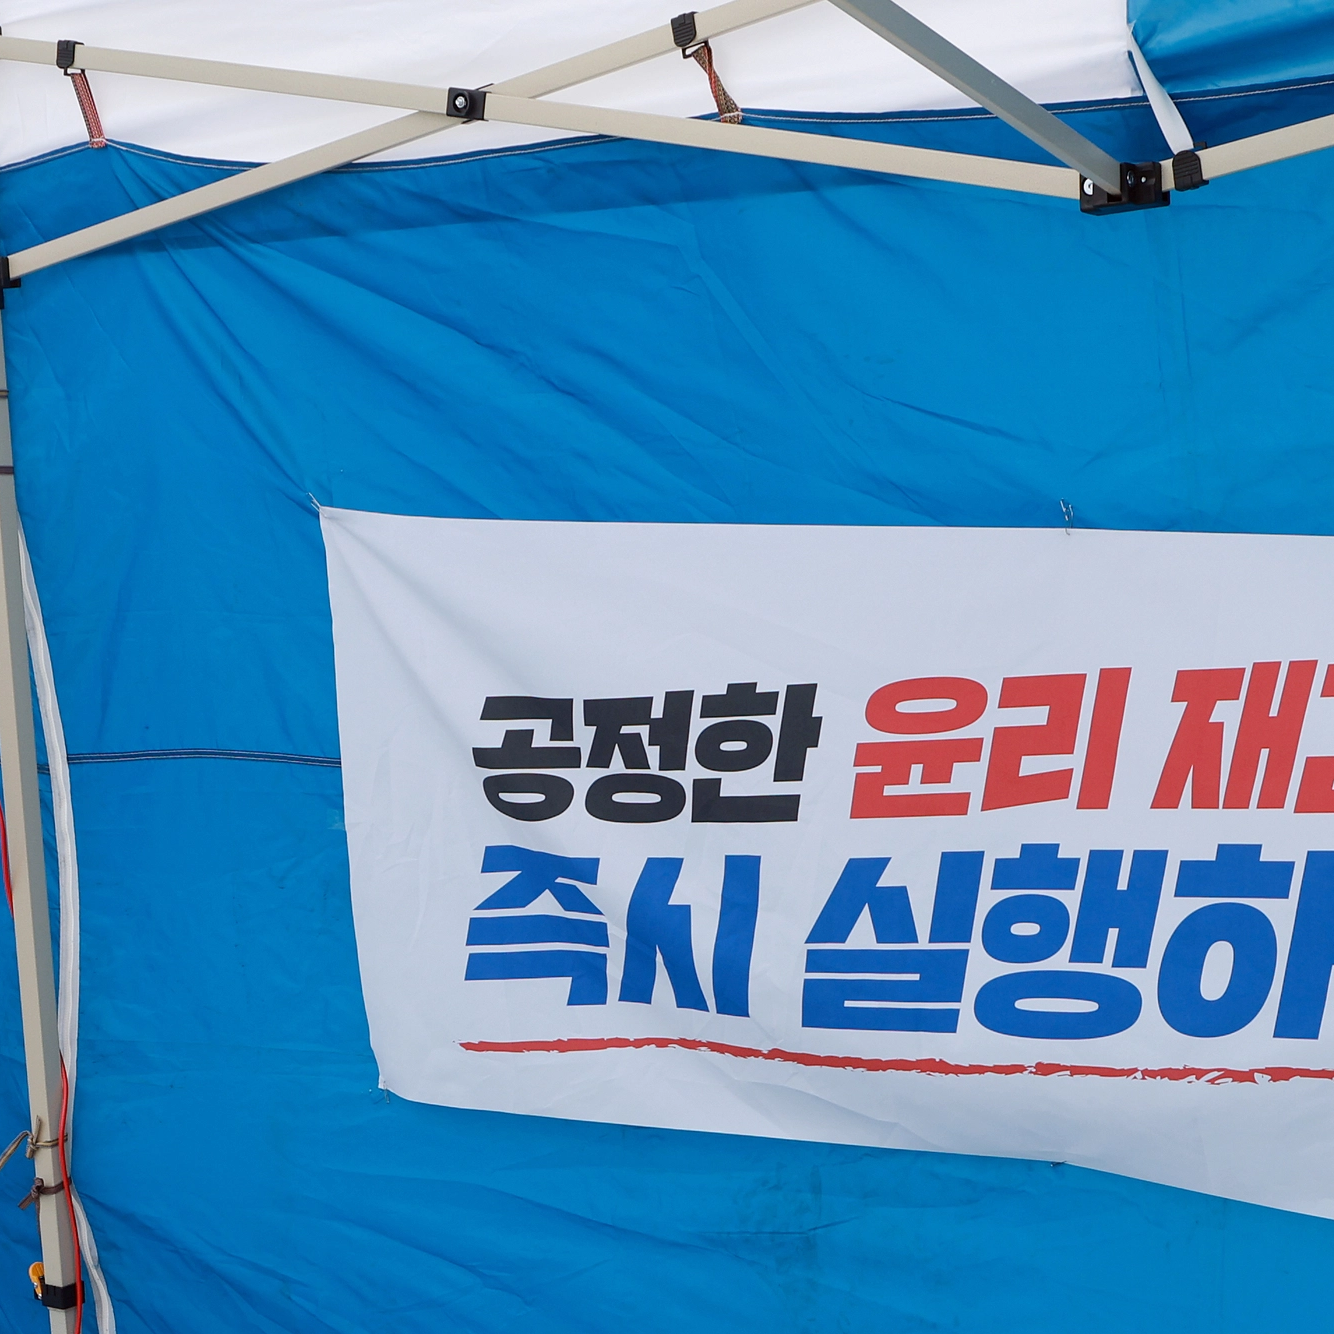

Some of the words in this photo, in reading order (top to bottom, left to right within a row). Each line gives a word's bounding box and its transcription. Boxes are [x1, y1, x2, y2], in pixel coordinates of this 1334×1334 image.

[472, 681, 823, 824] 공정한
[850, 667, 1132, 819] 윤리
[464, 844, 762, 1017] 즉시
